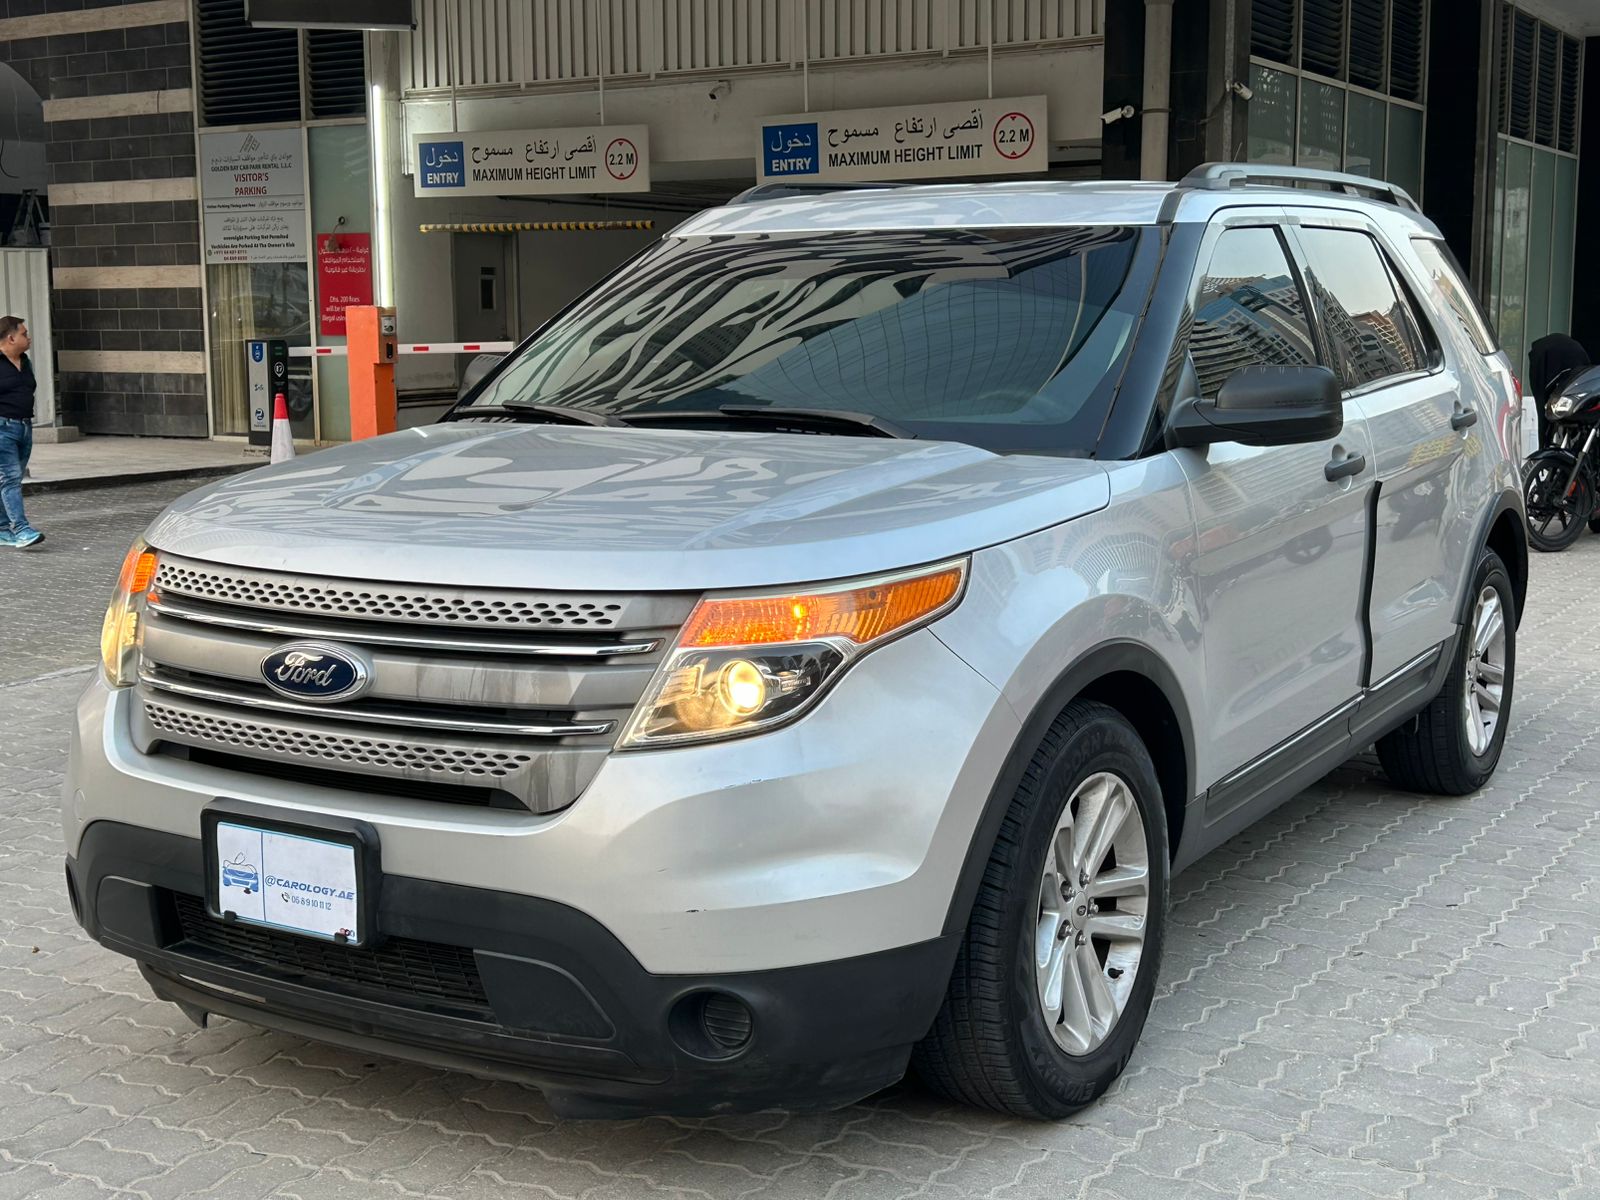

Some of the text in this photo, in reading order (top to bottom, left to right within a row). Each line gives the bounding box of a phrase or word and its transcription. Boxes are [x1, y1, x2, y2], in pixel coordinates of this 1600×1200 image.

[827, 108, 983, 147] أقصى ارتفاع مسموح
[998, 128, 1029, 144] 2.2 M
[471, 135, 597, 163] أقصى ارتفاع مسموح
[771, 130, 811, 153] دخول
[425, 147, 459, 168] دخول
[609, 152, 635, 165] 2.2 M
[772, 157, 812, 172] ENTRY
[828, 144, 983, 168] MAXIMUM HEIGHT LIMIT
[234, 172, 269, 182] VISITOR'S
[427, 172, 459, 184] ENTRY
[472, 165, 597, 182] MAXIMUM HEIGHT LIMIT
[234, 186, 267, 195] PARKING
[275, 651, 336, 687] Ford
[265, 875, 355, 900] @CAROLOGY.AE
